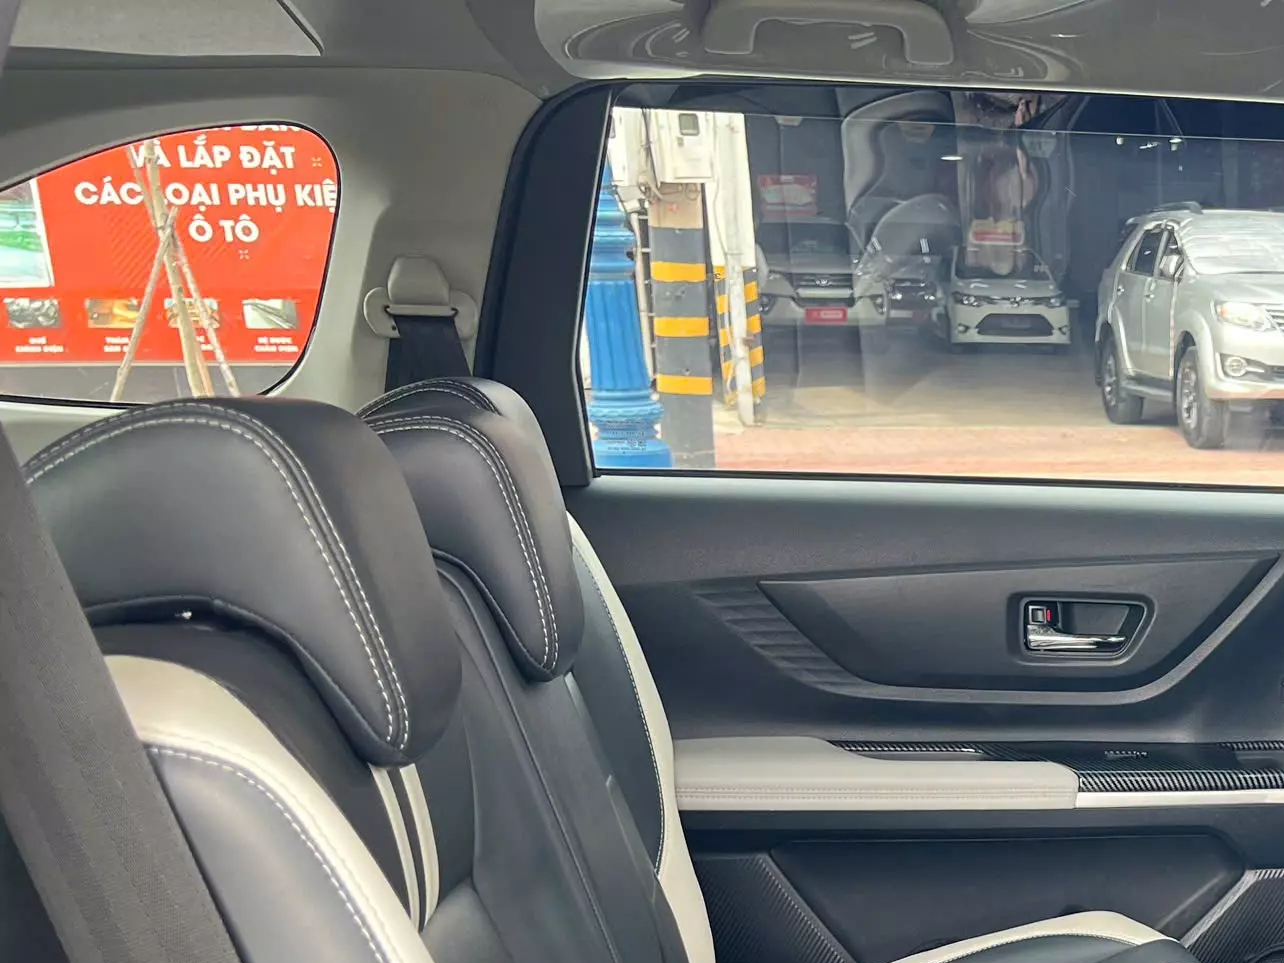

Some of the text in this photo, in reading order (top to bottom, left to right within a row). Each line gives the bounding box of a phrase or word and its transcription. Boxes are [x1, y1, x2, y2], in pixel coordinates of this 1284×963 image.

[177, 134, 231, 169] LẮP
[239, 140, 295, 175] ĐẶT
[74, 176, 144, 206] CÁC
[162, 182, 220, 212] OẠI
[227, 183, 285, 213] PHỤ
[188, 213, 259, 243] Ô TÔ
